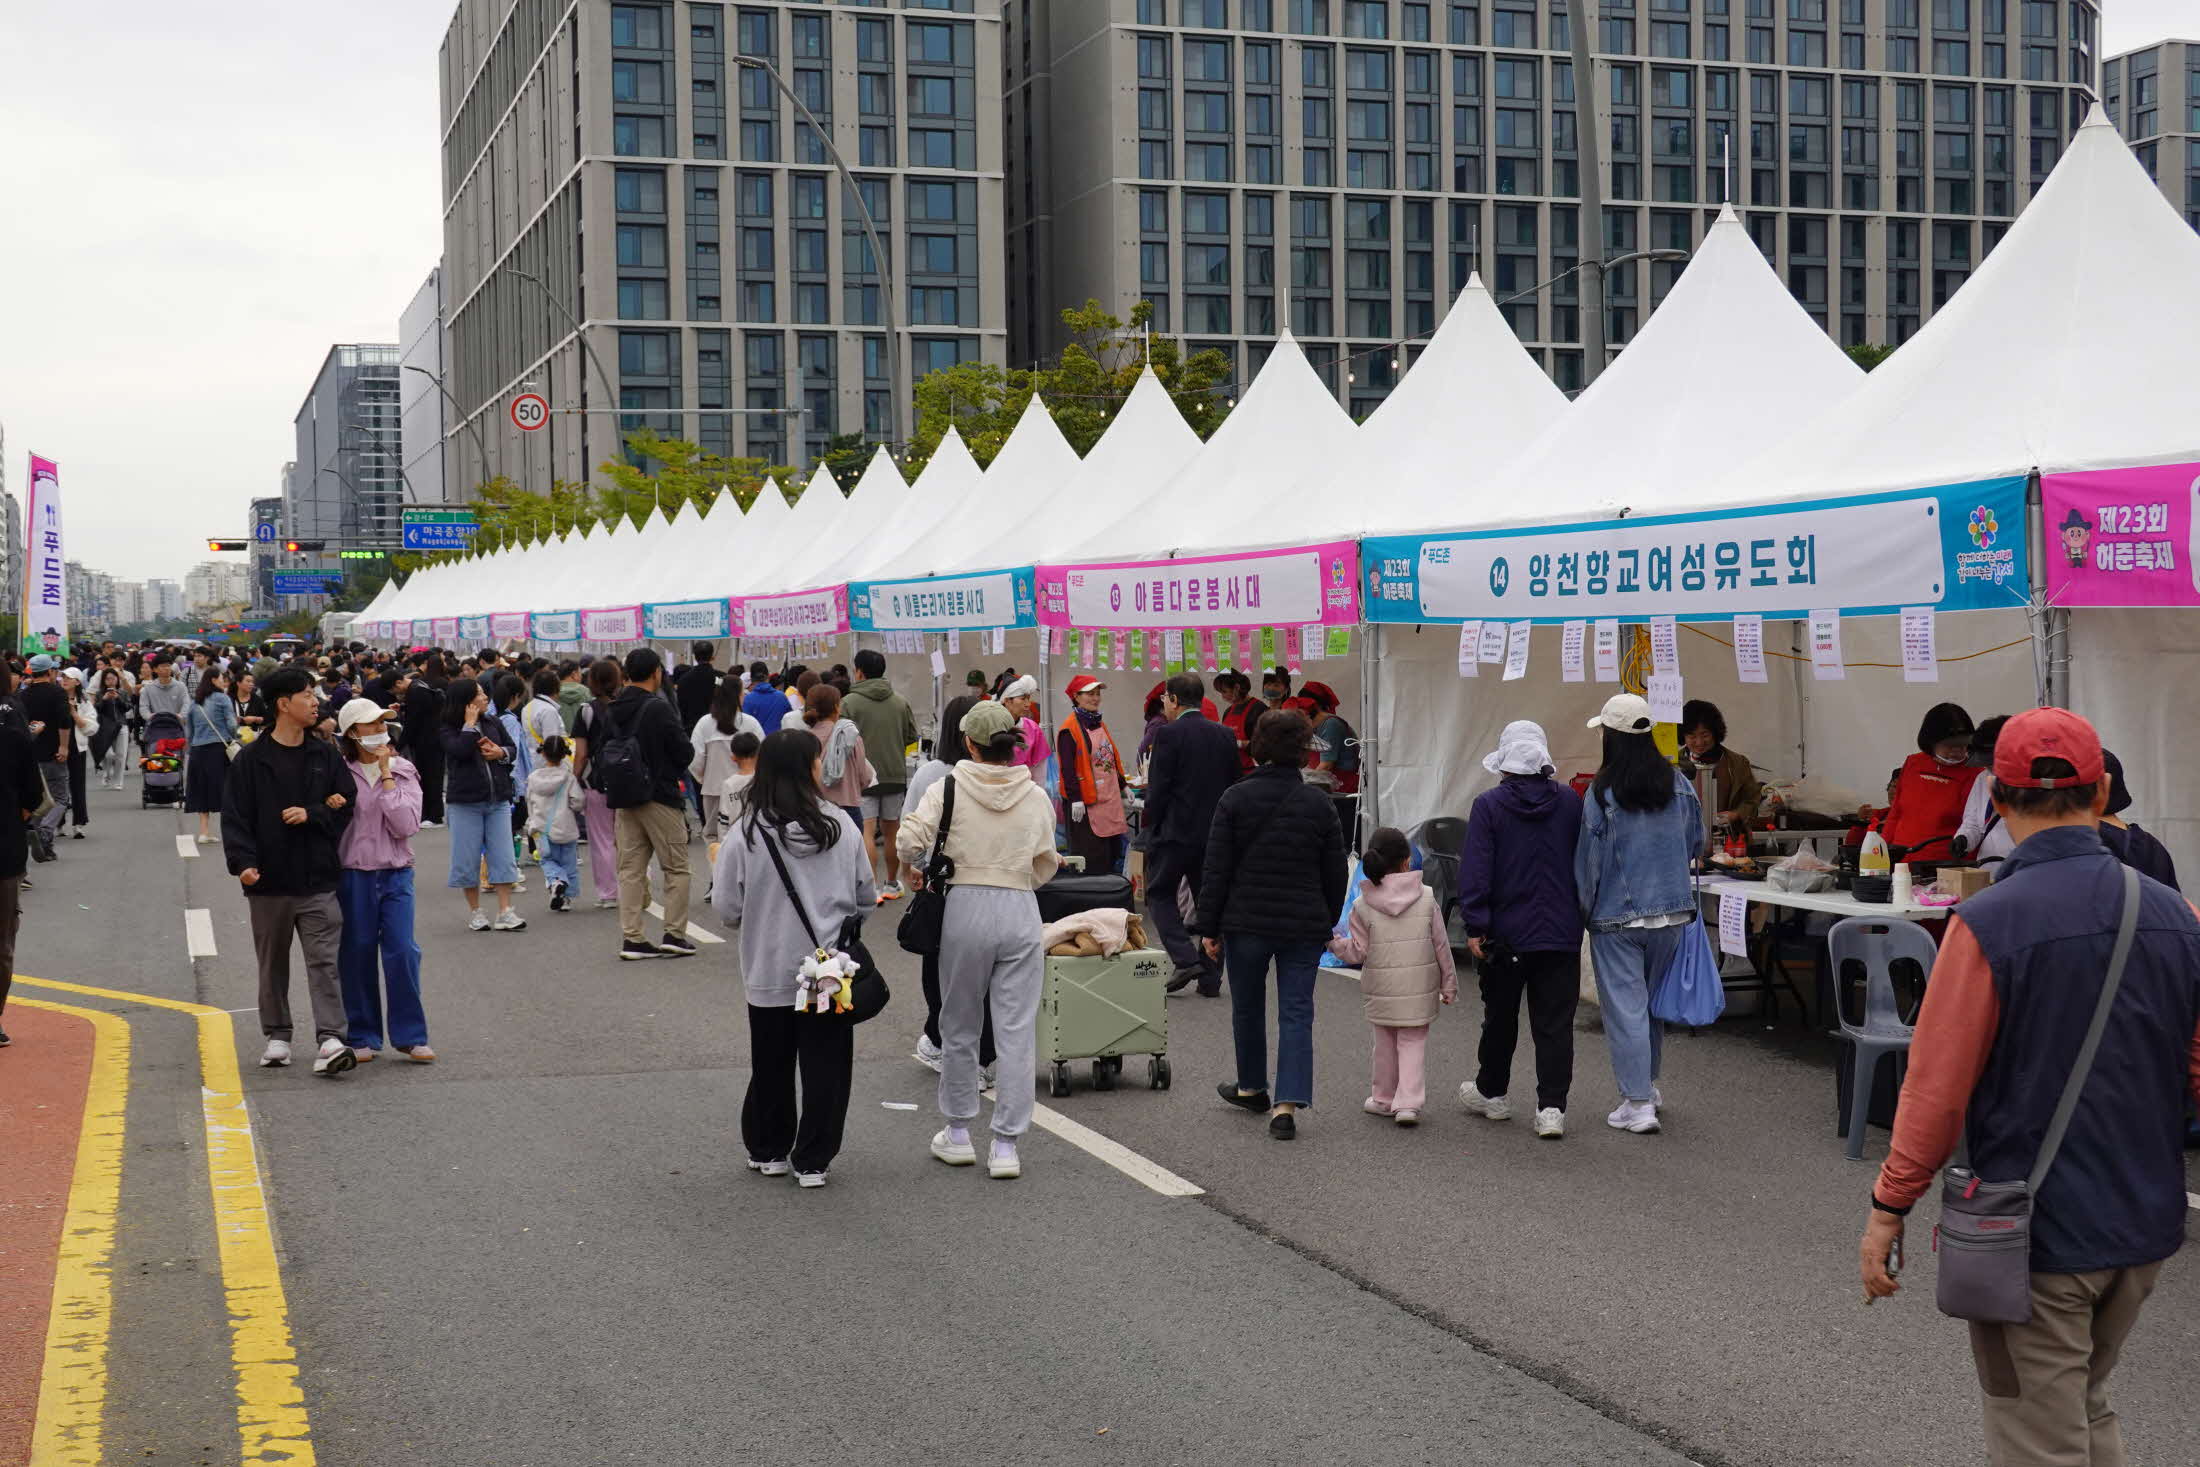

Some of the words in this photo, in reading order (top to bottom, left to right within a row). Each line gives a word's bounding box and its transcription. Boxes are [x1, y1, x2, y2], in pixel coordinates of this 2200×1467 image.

[519, 403, 541, 421] 50
[2097, 503, 2168, 535] 제23회
[42, 530, 61, 606] 푸드존
[1383, 558, 1411, 577] 제23회
[1428, 547, 1451, 564] 푸드존
[1493, 565, 1506, 588] 14
[1528, 534, 1817, 597] 양천향교여성유도회
[2096, 541, 2175, 572] 허준축제
[1992, 561, 2014, 584] 강서
[1135, 574, 1261, 613] 아름다운봉사대
[1382, 582, 1414, 601] 허준축제
